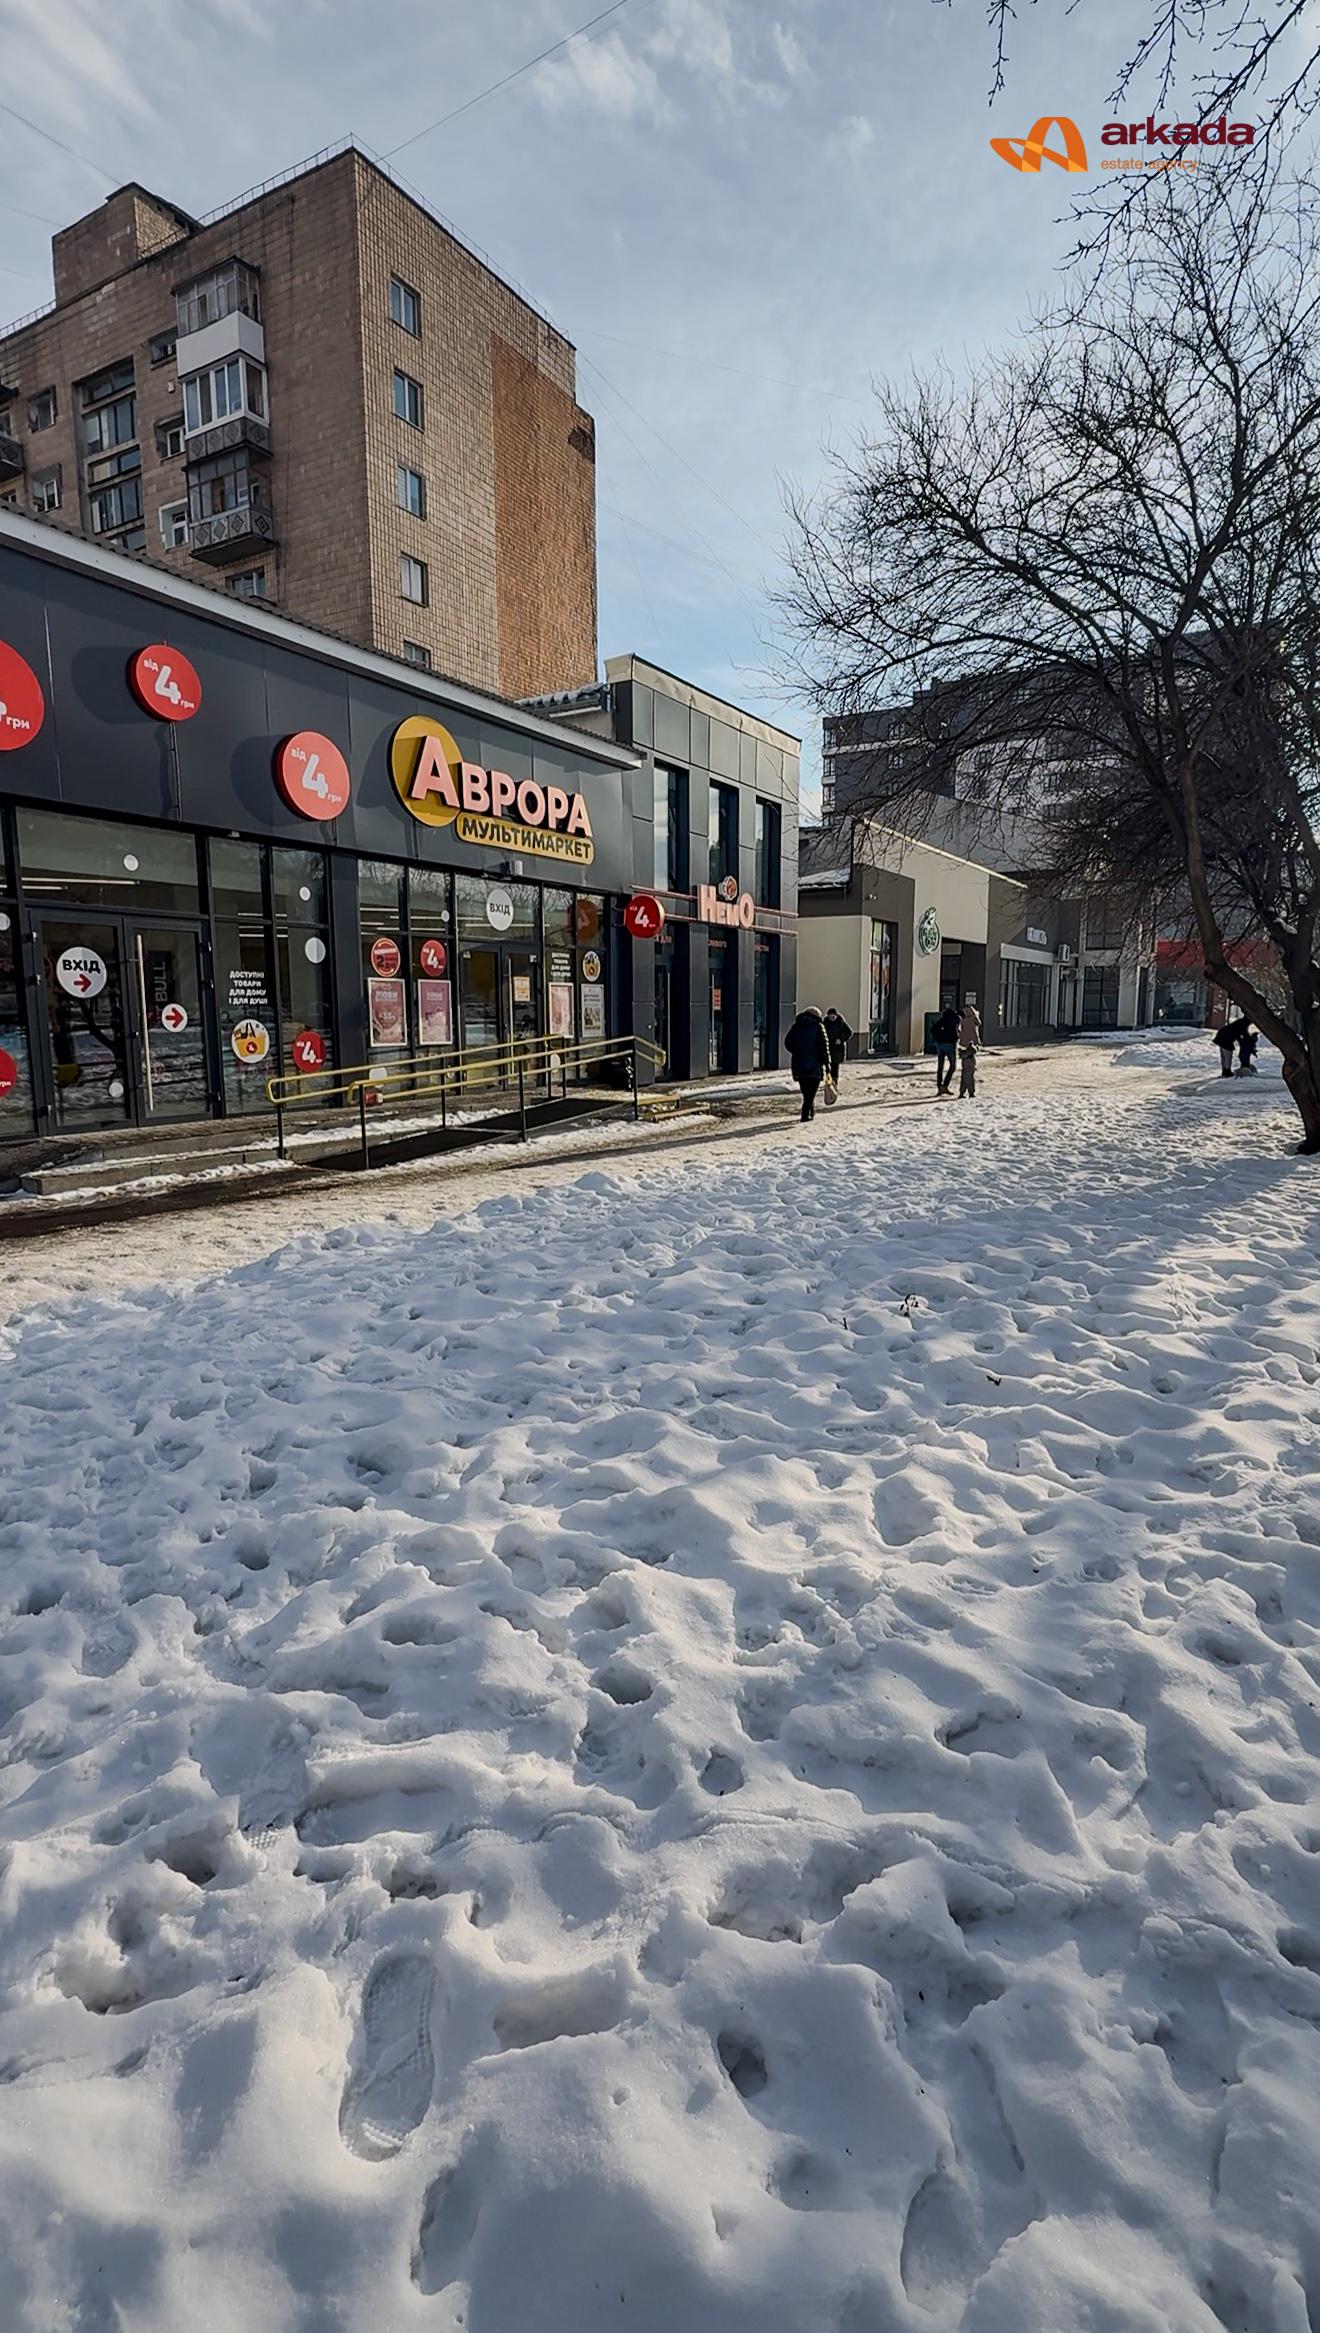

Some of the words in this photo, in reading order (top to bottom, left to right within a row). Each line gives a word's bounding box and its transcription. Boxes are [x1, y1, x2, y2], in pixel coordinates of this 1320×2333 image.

[144, 659, 159, 672] від
[155, 665, 181, 705] 4
[6, 716, 30, 730] грн
[291, 747, 307, 762] від
[302, 753, 328, 799] 4
[462, 816, 591, 859] МУЛЬТИМАРКЕТ
[489, 902, 511, 916] ВХІД
[634, 905, 650, 928] 4
[62, 959, 101, 974] ВХІД
[427, 948, 439, 969] 4
[302, 1041, 316, 1064] 4
